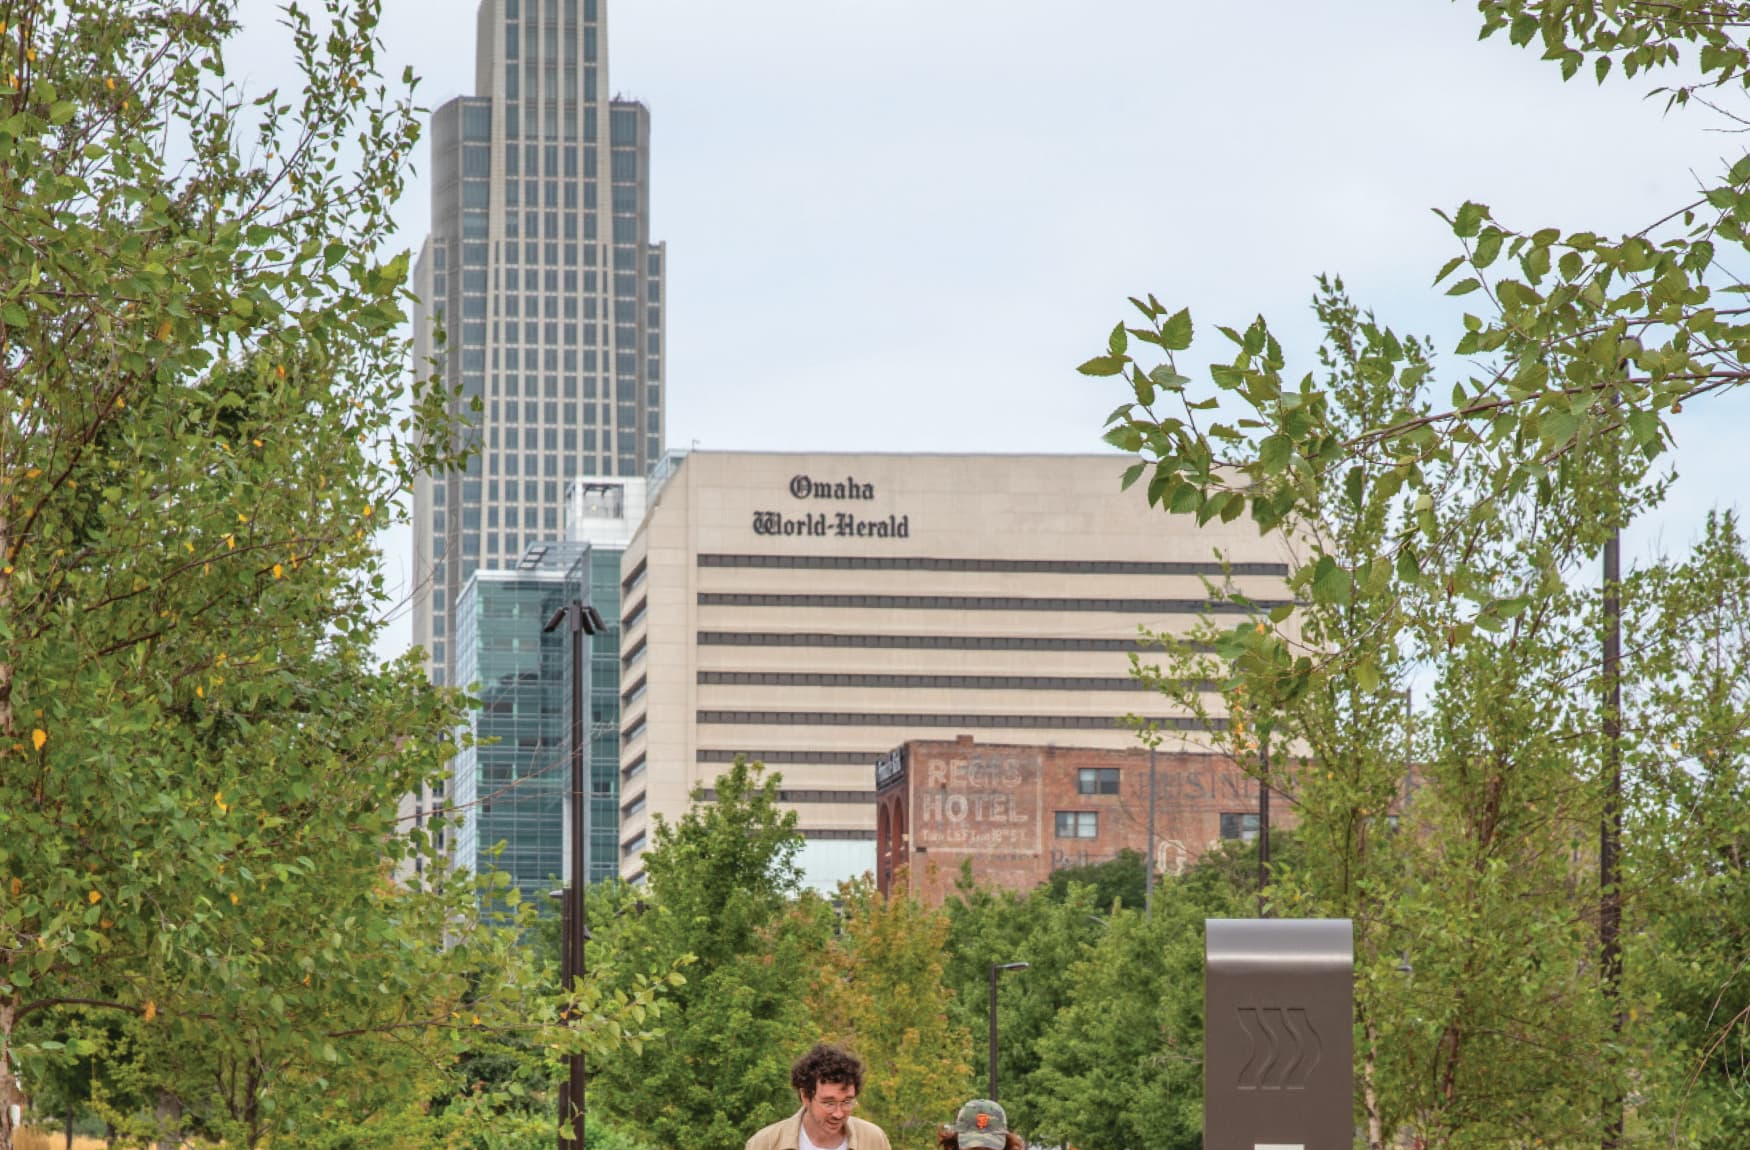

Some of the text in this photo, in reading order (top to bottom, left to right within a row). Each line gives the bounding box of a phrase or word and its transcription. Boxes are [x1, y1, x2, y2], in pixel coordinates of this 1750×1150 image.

[789, 474, 874, 500] Omaha
[753, 510, 909, 538] World-Herald
[923, 793, 1029, 822] HOTEL
